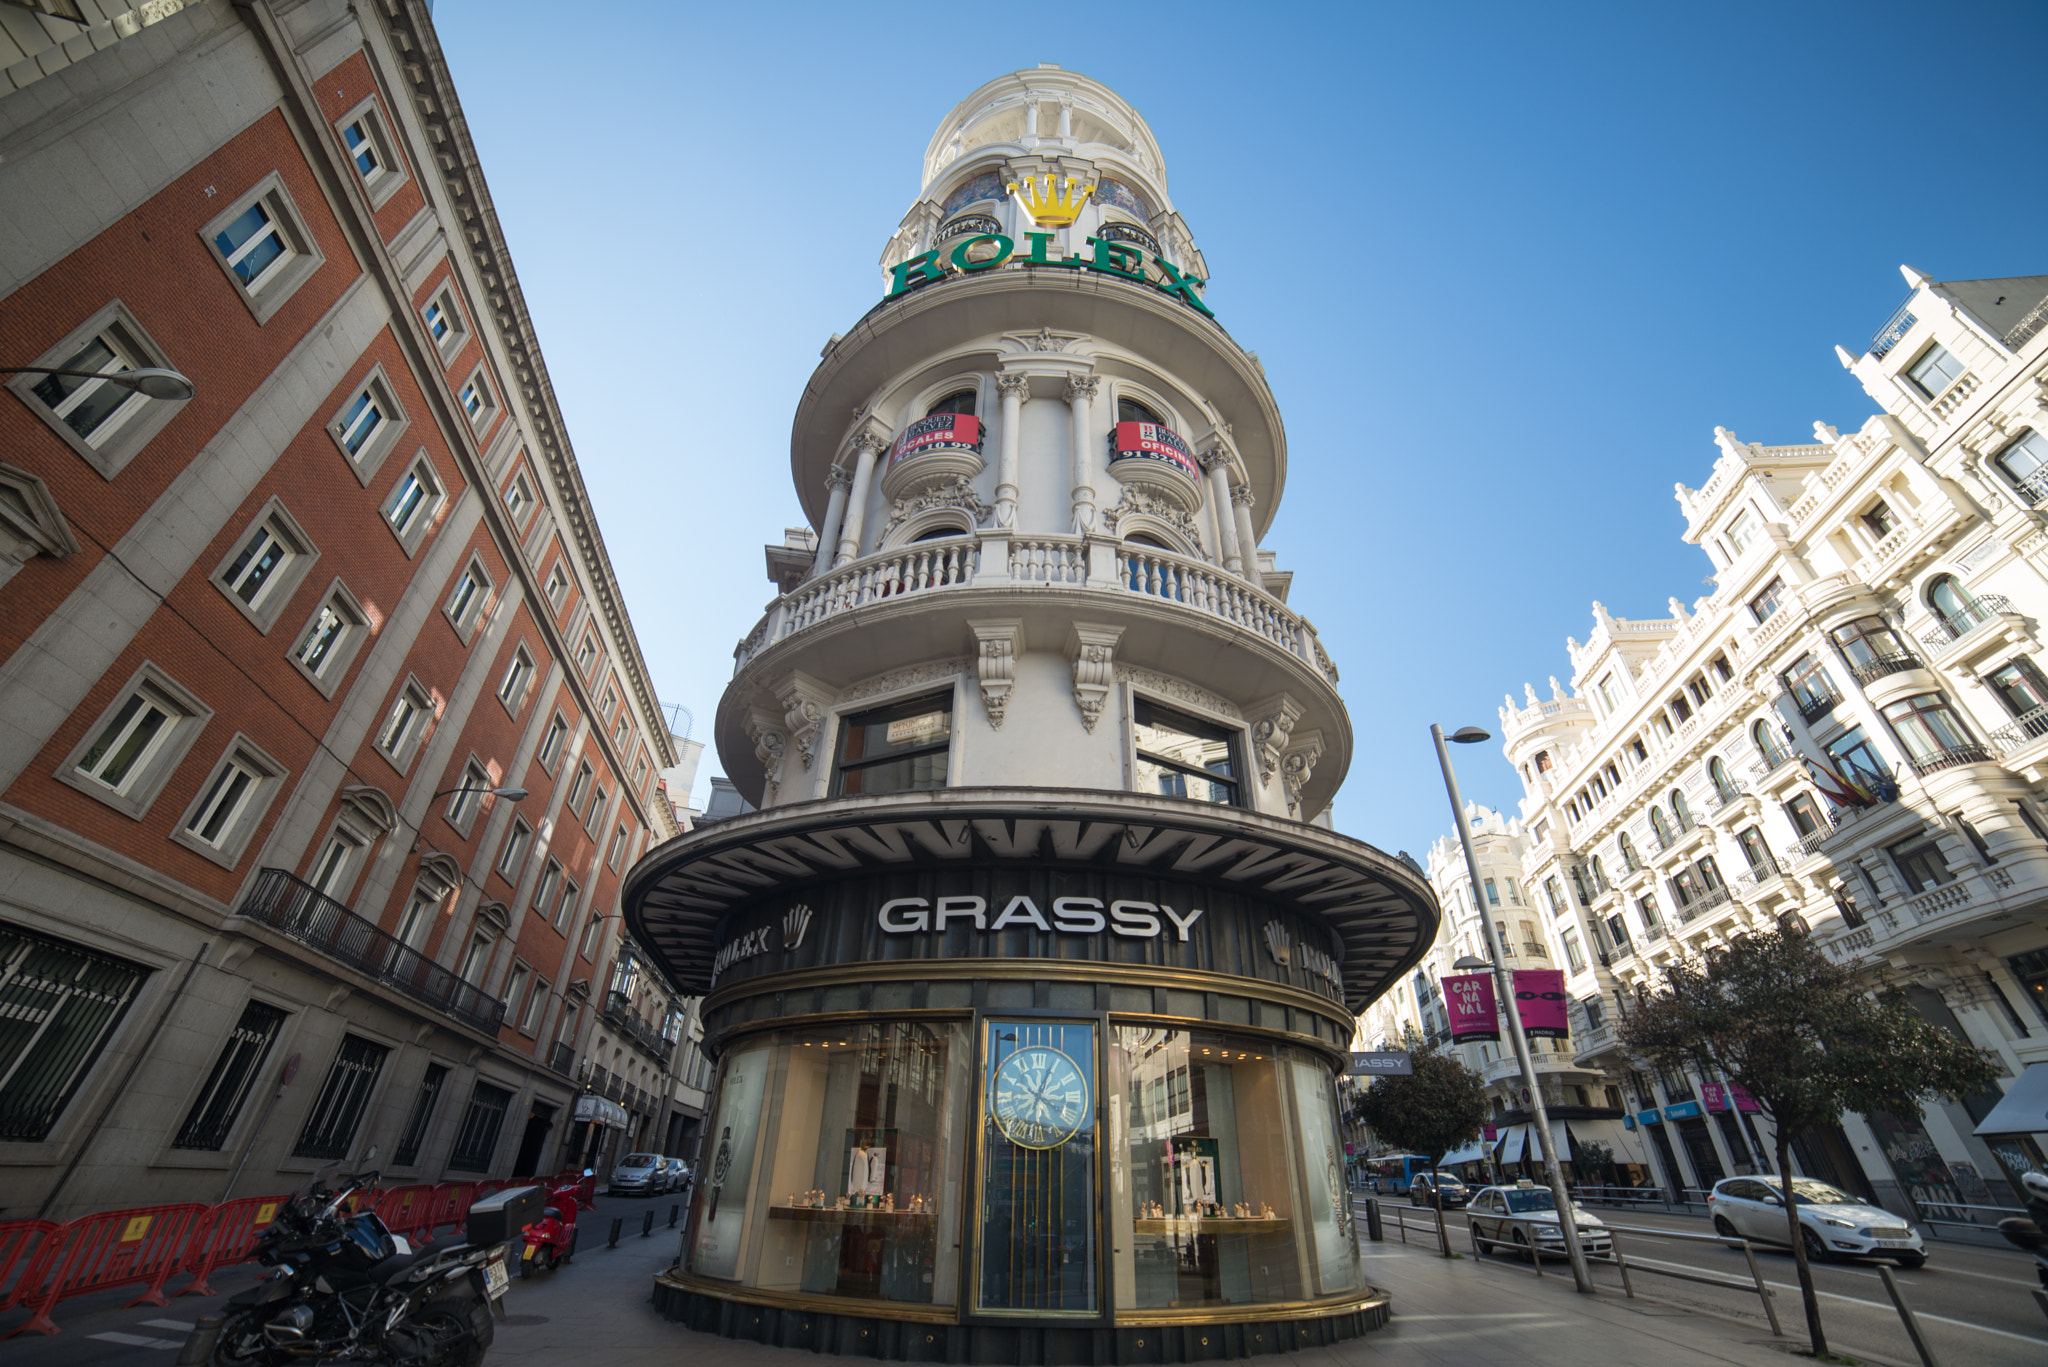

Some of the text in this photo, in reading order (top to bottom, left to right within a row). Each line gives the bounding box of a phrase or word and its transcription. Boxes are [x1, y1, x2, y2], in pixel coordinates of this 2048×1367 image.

[884, 232, 1214, 318] ROLEX
[908, 421, 952, 438] GALVEZ
[927, 441, 945, 450] 10
[951, 441, 972, 450] 99
[1122, 450, 1143, 458] 91
[1149, 452, 1177, 466] 524
[878, 896, 1204, 941] GRASSY
[1452, 980, 1482, 993] CAR
[1462, 992, 1480, 1004] NA
[1457, 1003, 1486, 1015] VAL
